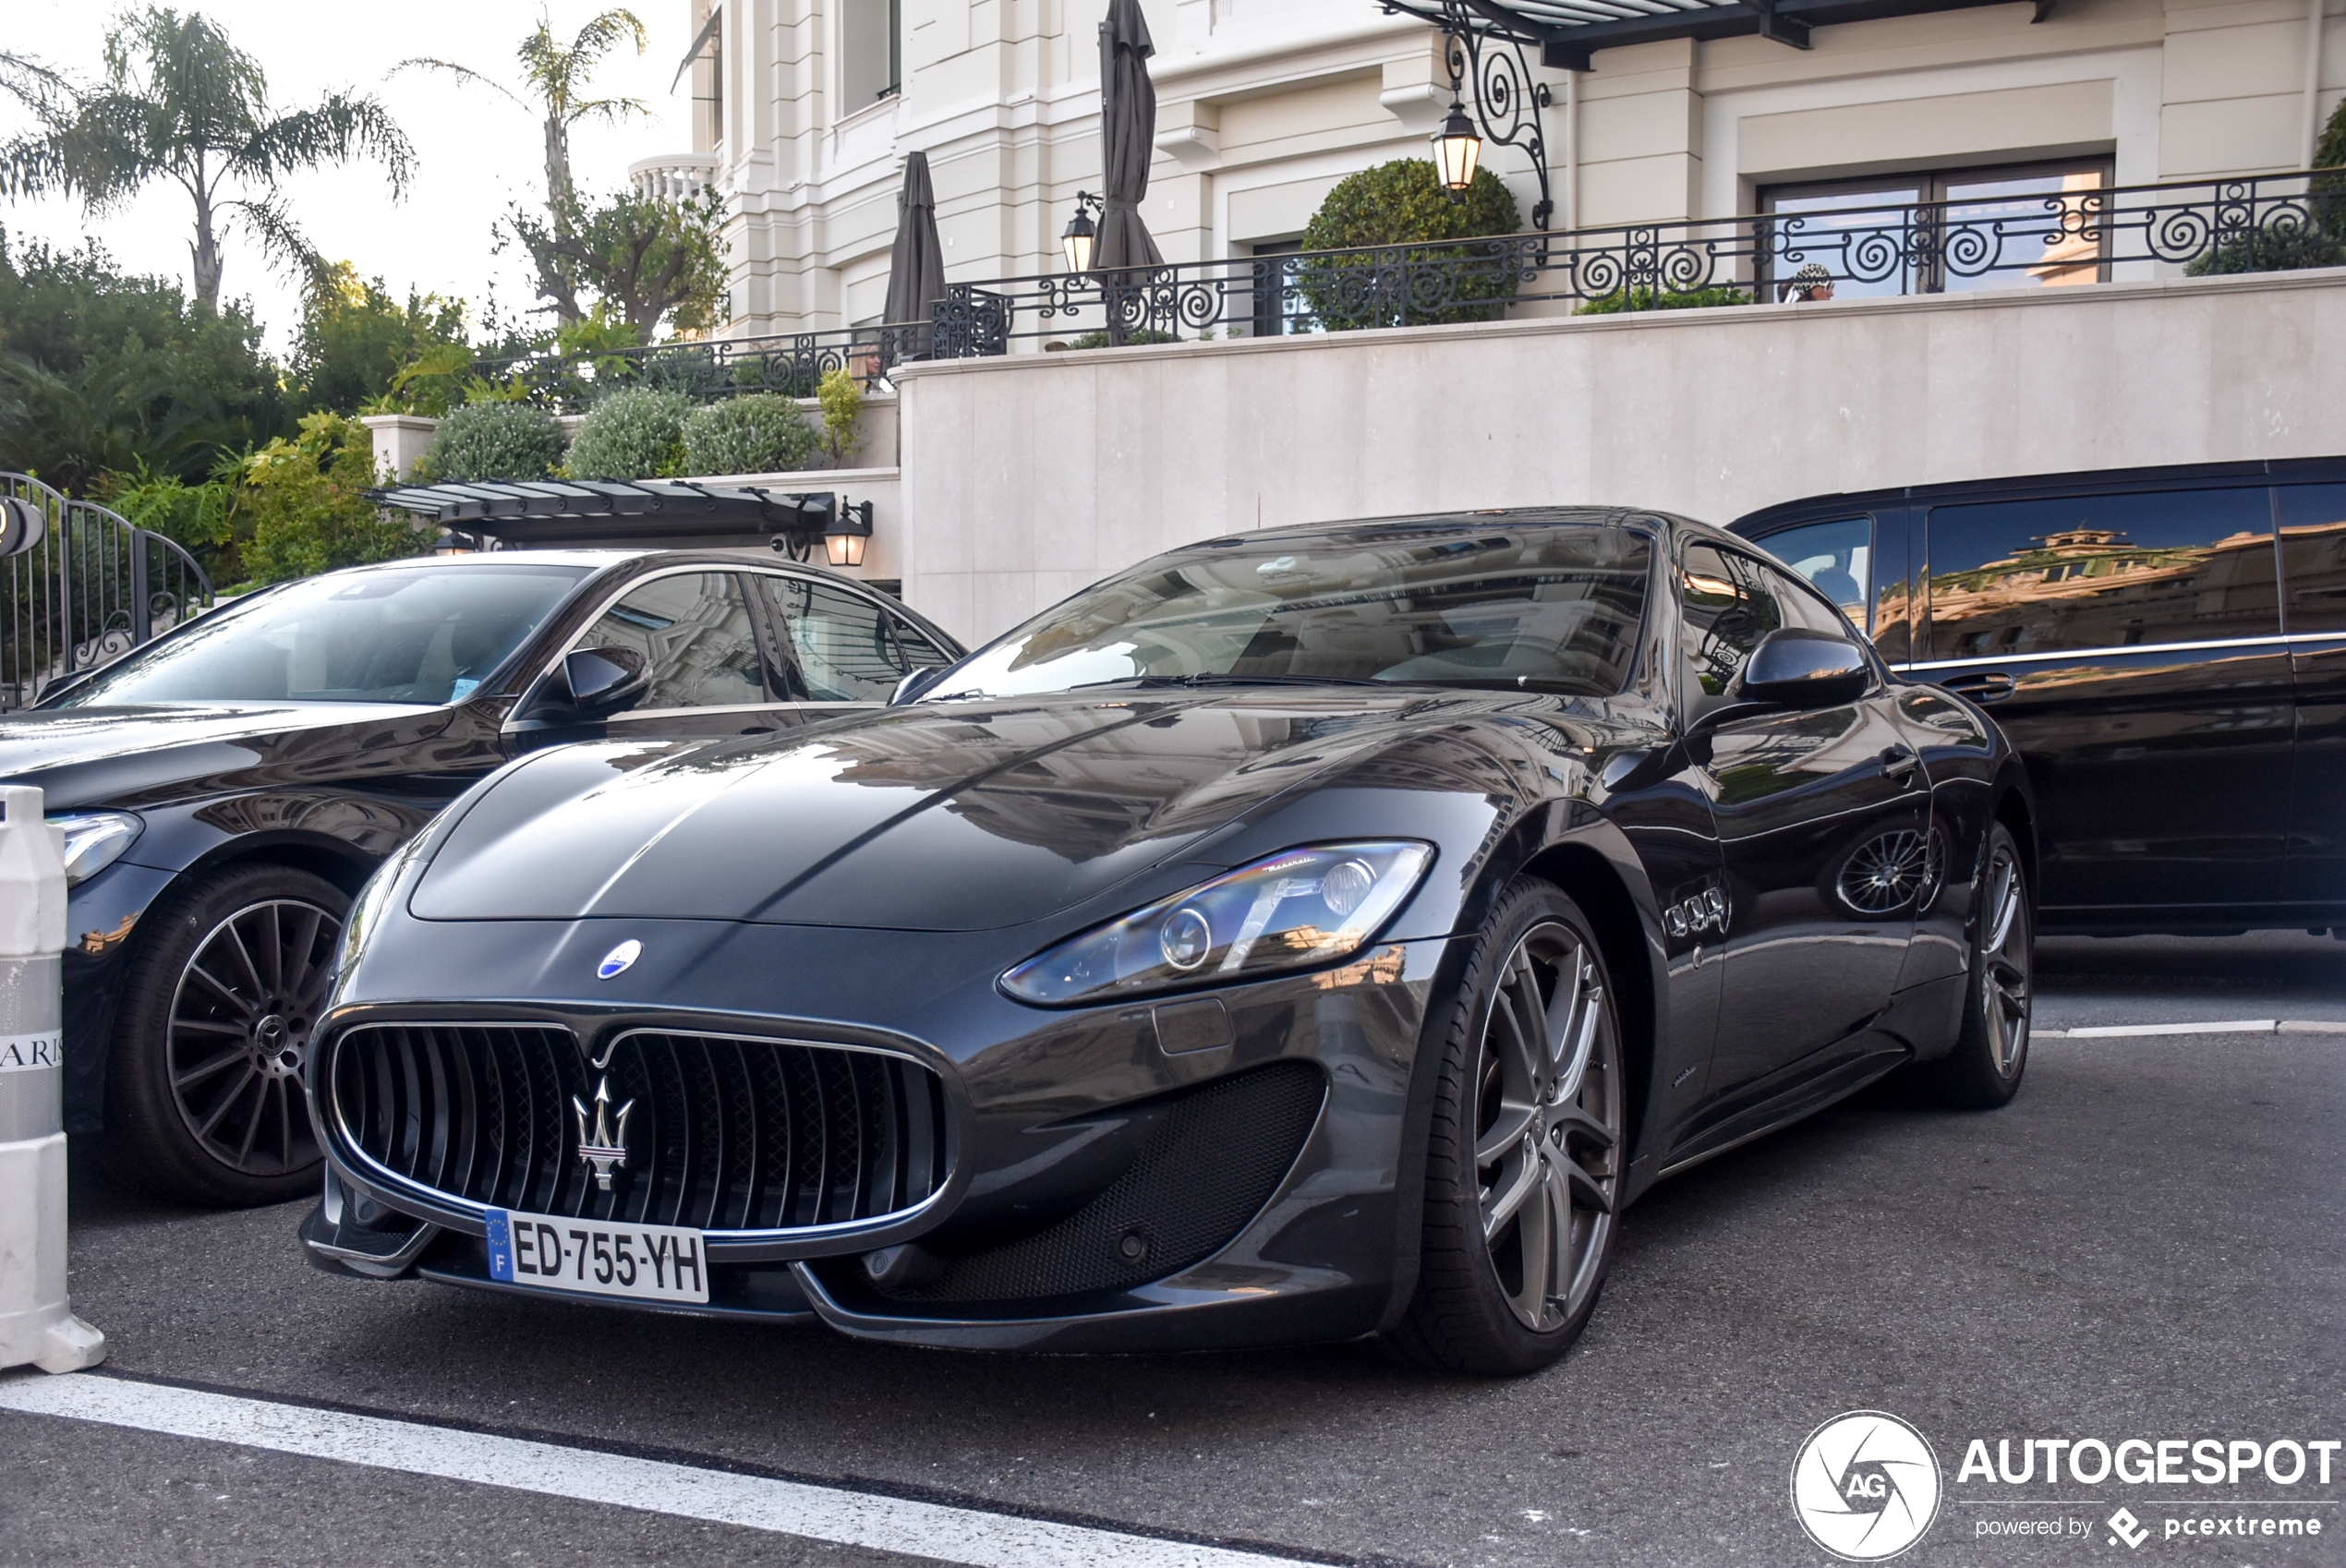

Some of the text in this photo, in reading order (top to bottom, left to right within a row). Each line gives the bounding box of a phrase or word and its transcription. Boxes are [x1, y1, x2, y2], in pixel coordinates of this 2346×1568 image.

[1263, 856, 1316, 872] Maserati
[497, 1255, 504, 1272] F
[513, 1220, 702, 1293] ED-755-YH
